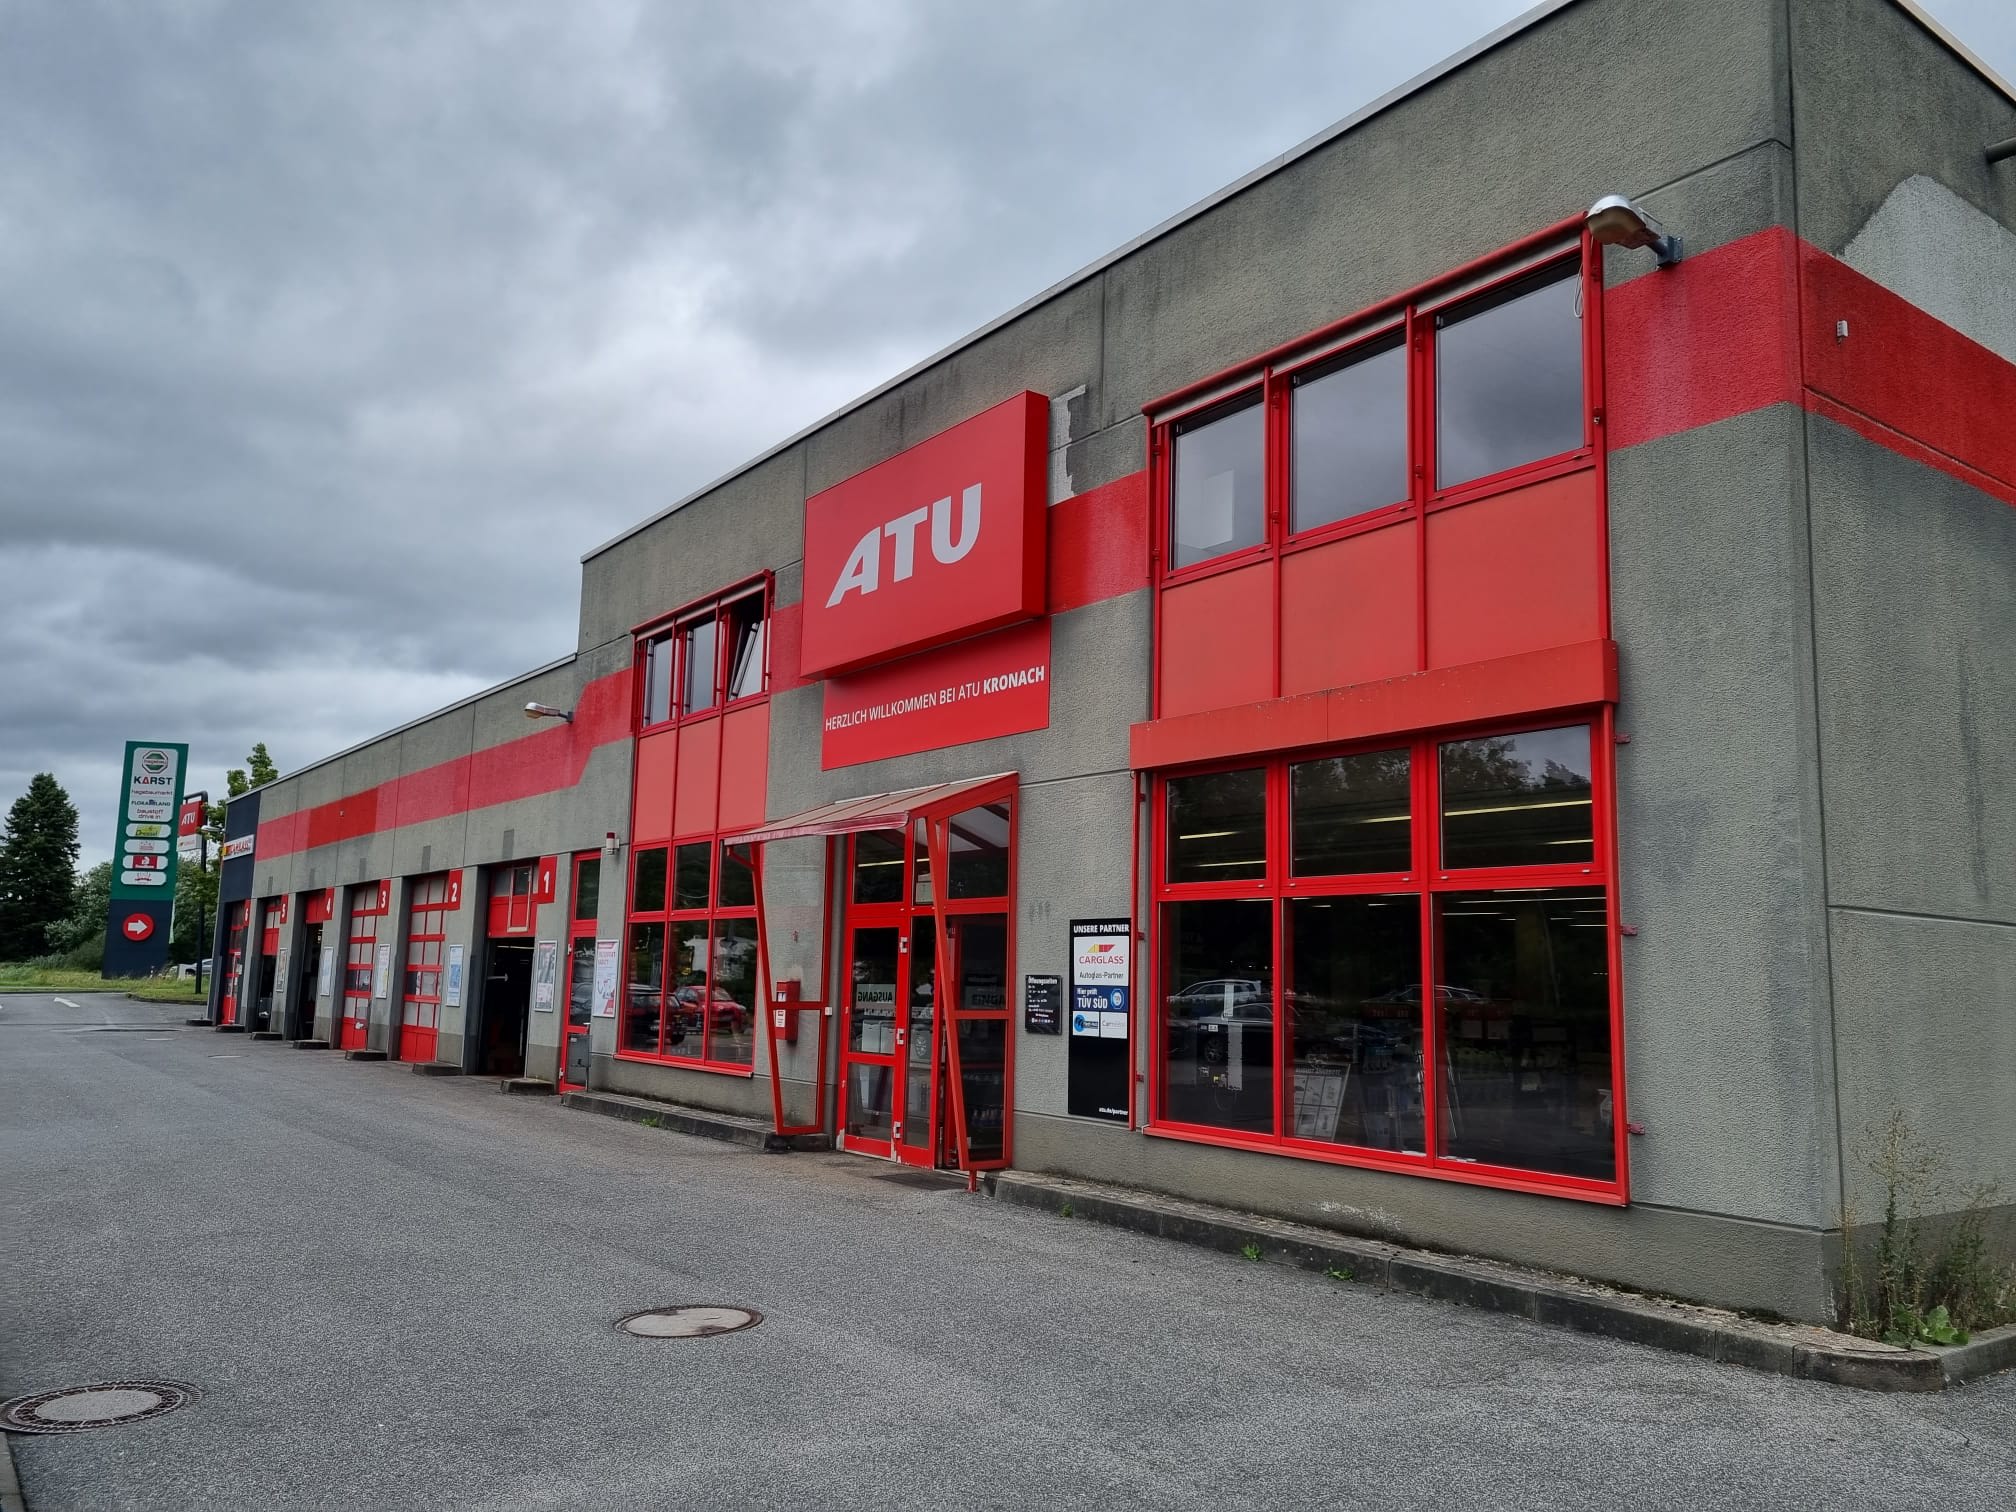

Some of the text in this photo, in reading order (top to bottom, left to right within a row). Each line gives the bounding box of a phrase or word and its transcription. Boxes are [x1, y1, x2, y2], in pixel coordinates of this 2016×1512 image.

[825, 482, 982, 608] ATU
[825, 665, 1044, 731] HERZLICH WILLKOMMEN BEI ATU KRONACH
[133, 776, 172, 785] KARST
[181, 812, 195, 825] ATU
[543, 871, 550, 894] 1
[380, 890, 387, 909] 3
[451, 882, 458, 902] 2
[281, 904, 286, 918] 5
[326, 897, 331, 914] 4
[1073, 924, 1129, 933] UNSERE PARTNER
[1078, 955, 1124, 965] CARGLASS
[1079, 971, 1124, 979] Autoglas-Partner
[1077, 994, 1092, 1008] TÜV
[1093, 995, 1108, 1009] SÜD
